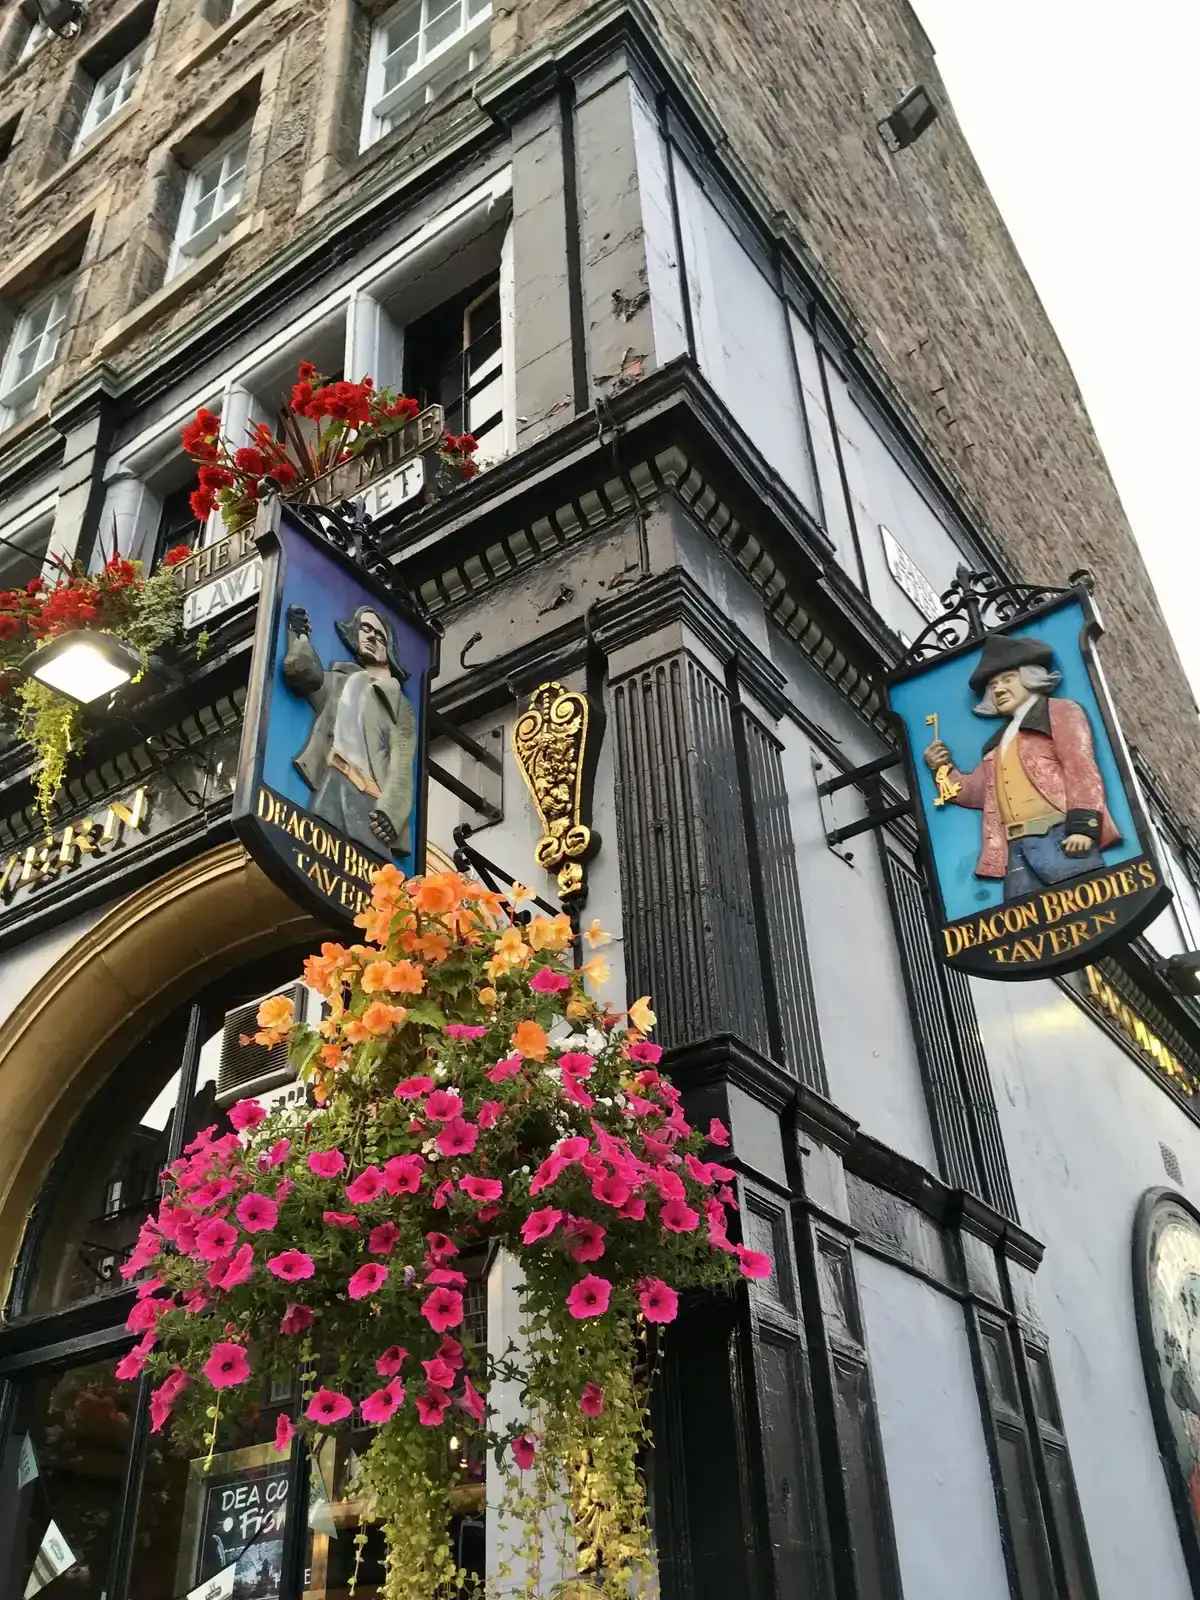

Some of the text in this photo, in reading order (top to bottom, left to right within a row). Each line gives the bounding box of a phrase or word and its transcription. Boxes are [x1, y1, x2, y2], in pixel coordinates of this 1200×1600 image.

[173, 538, 231, 592] THE
[355, 412, 435, 488] MILE
[257, 786, 381, 886] DEACON BRO
[292, 847, 372, 914] TAVER
[941, 860, 1158, 957] DEACON BRODIE'S
[988, 908, 1117, 963] TAVERN
